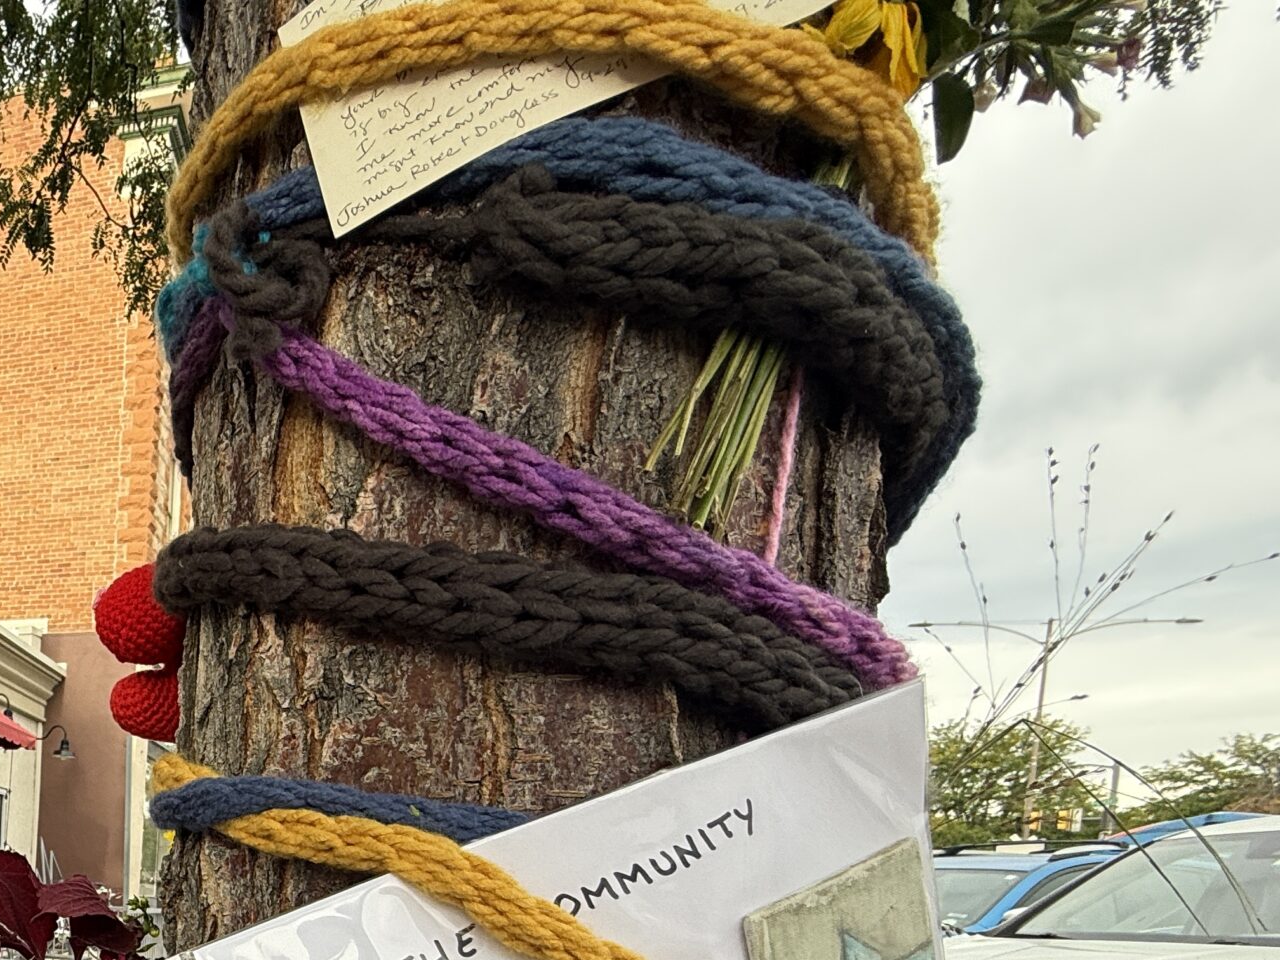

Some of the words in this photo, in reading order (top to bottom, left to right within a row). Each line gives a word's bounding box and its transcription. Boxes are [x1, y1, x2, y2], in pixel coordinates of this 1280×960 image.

[526, 55, 585, 88] my
[378, 92, 418, 119] big
[357, 149, 395, 173] me
[407, 106, 464, 141] more
[337, 181, 407, 227] Joshua
[410, 136, 469, 179] Robert
[554, 798, 753, 917] OMMUNITY
